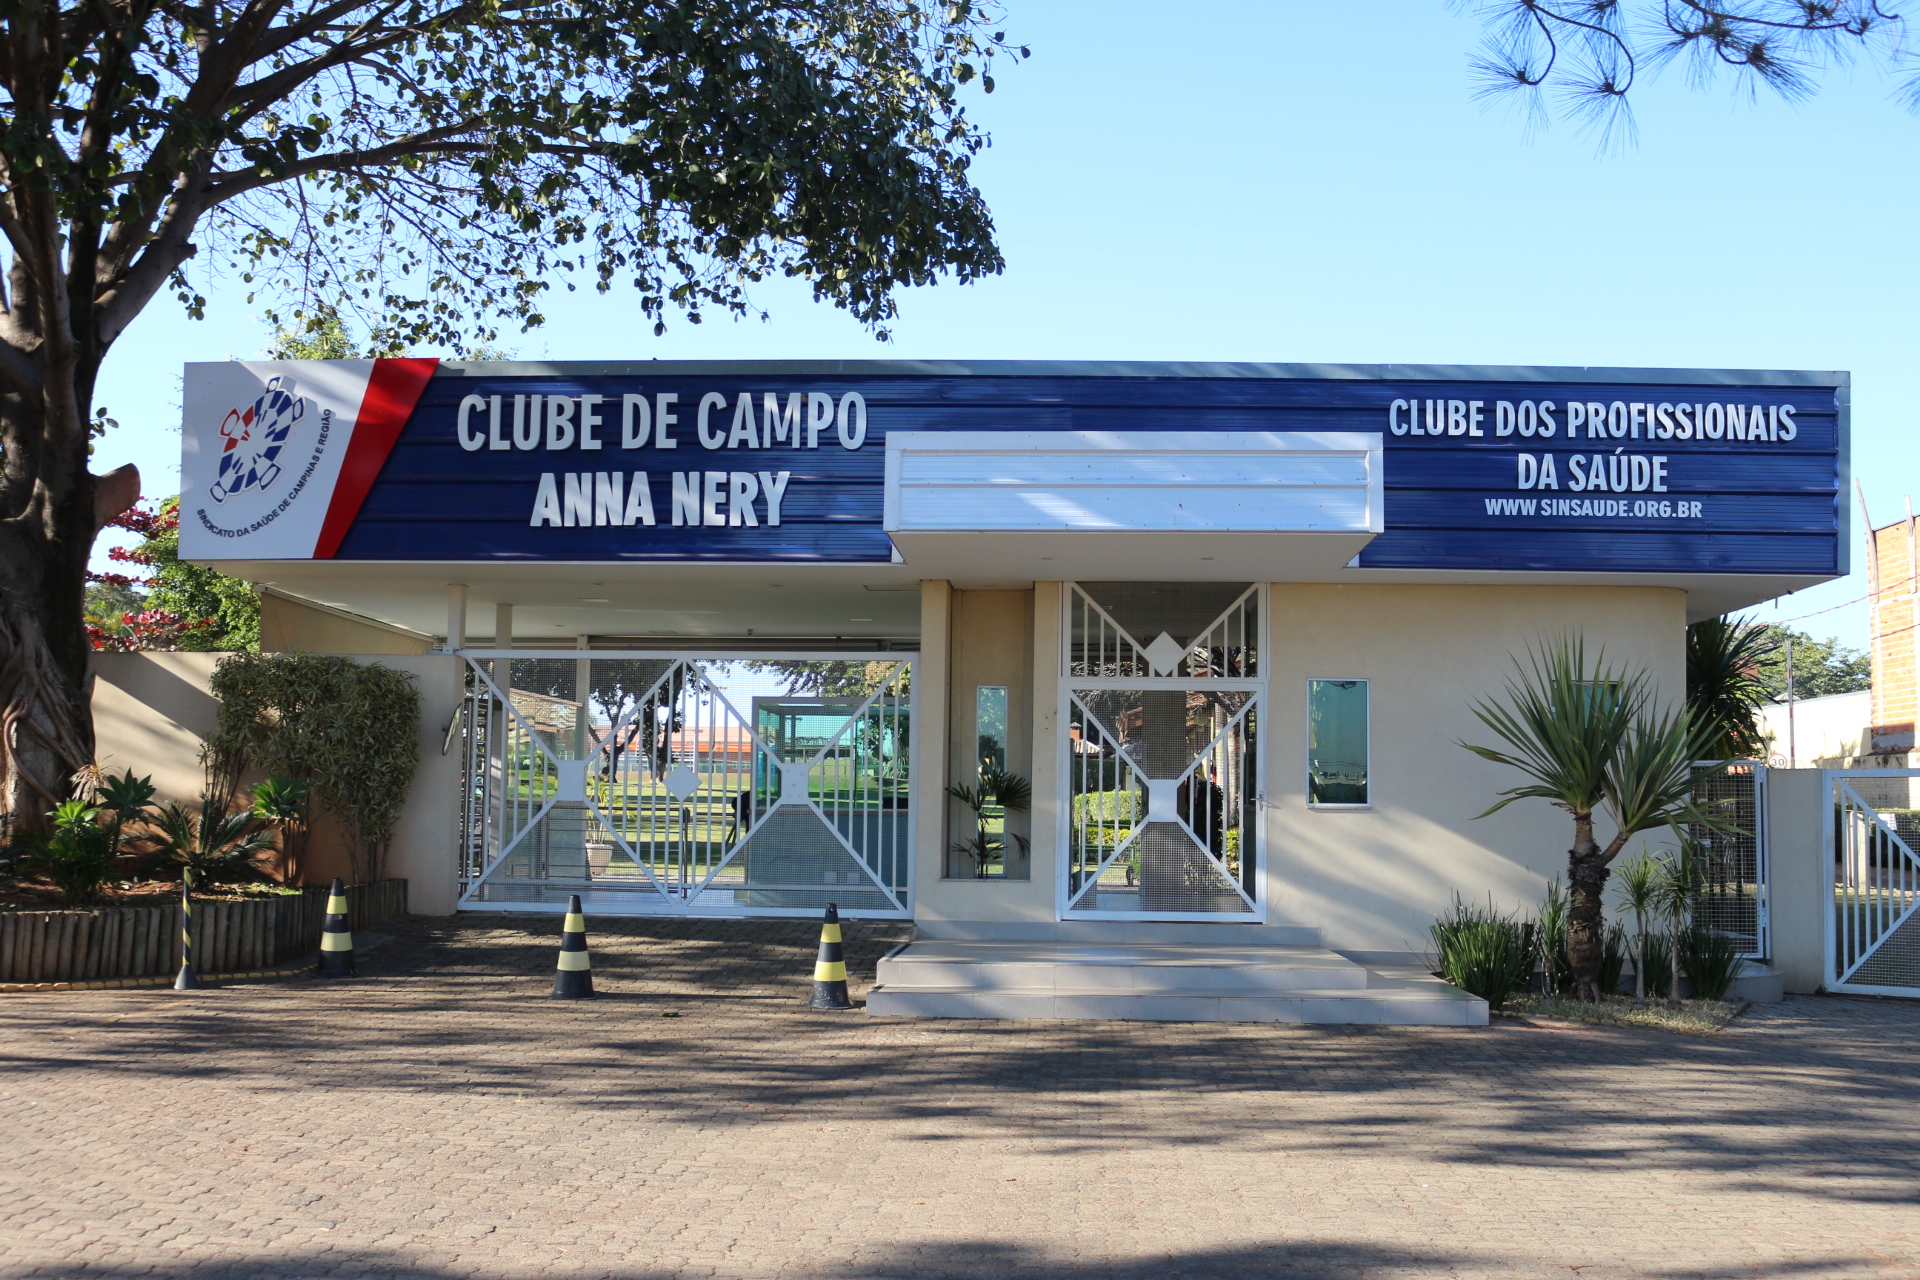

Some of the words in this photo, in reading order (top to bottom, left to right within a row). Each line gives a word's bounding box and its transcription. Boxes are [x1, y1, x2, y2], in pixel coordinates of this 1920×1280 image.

[318, 408, 332, 446] REGIÃO
[457, 394, 603, 451] CLUBE
[622, 393, 678, 449] DE
[697, 391, 867, 450] CAMPO
[1389, 399, 1484, 437] CLUBE
[1496, 400, 1556, 438] DOS
[1567, 401, 1797, 441] PROFISSIONAIS
[315, 446, 324, 455] E
[288, 455, 320, 500] CAMPINAS
[1517, 453, 1559, 490] DA
[1568, 447, 1668, 492] SAÚDE
[278, 498, 291, 512] DE
[530, 472, 656, 527] ANNA
[671, 471, 790, 527] NERY
[1485, 499, 1537, 516] WWW
[1540, 499, 1703, 518] SINSAUDE.ORG.BR
[197, 508, 235, 538] SINDICATO
[236, 527, 250, 537] DA
[250, 508, 280, 532] SAÚDE
[1771, 758, 1785, 767] 30
